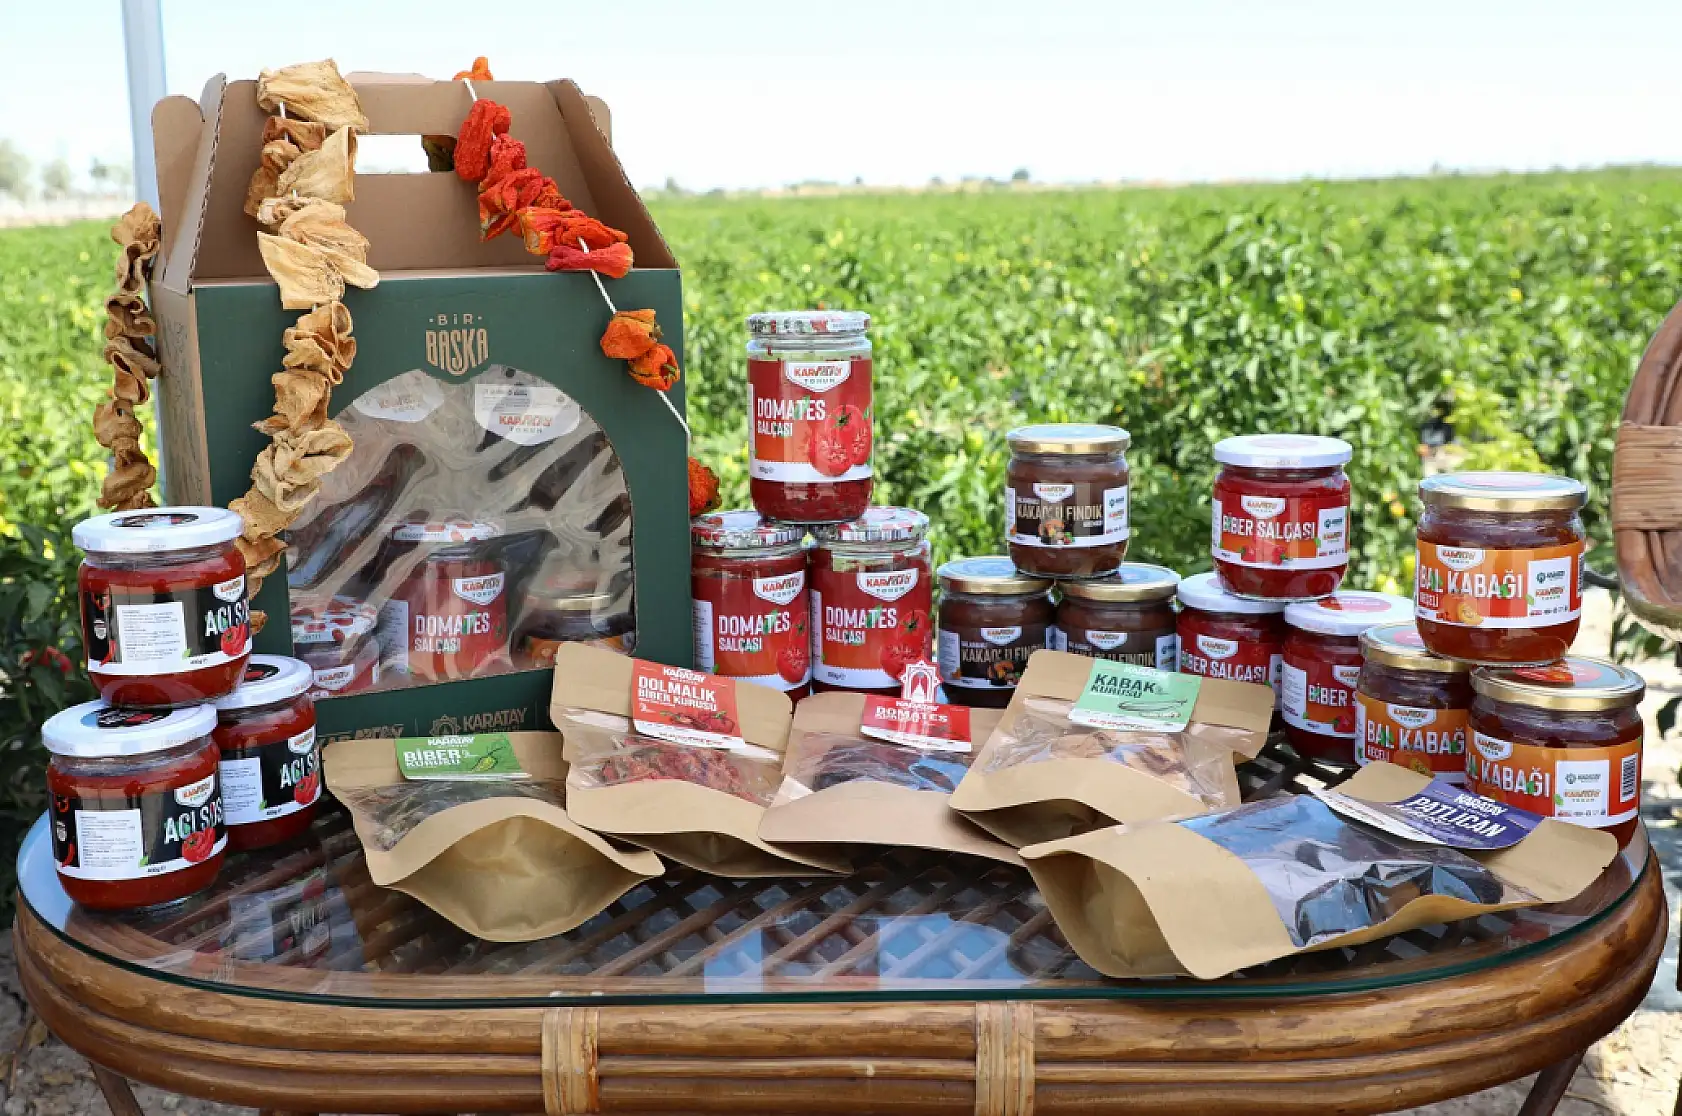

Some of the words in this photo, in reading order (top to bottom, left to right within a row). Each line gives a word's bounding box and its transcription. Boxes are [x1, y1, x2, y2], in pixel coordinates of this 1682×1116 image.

[757, 398, 826, 421] DOMATES
[1256, 518, 1316, 543] SALÇASI
[1447, 568, 1524, 598] KABAĞI
[414, 612, 492, 636] DOMATES
[718, 611, 790, 635] DOMATES
[825, 606, 898, 629] DOMATES
[718, 637, 763, 654] SALÇASI
[825, 627, 866, 645] SALÇASI
[637, 675, 717, 703] DOLMALIK
[1094, 673, 1157, 694] KABAK
[1308, 682, 1348, 707] BİBER
[463, 707, 528, 730] KARATAY
[876, 706, 949, 723] DOMATES
[1367, 719, 1395, 749] BAL
[1398, 726, 1465, 754] KABAĞ
[403, 748, 462, 762] BİBER
[1481, 758, 1551, 798] KABAĞI
[1406, 796, 1508, 838] PATLICAN
